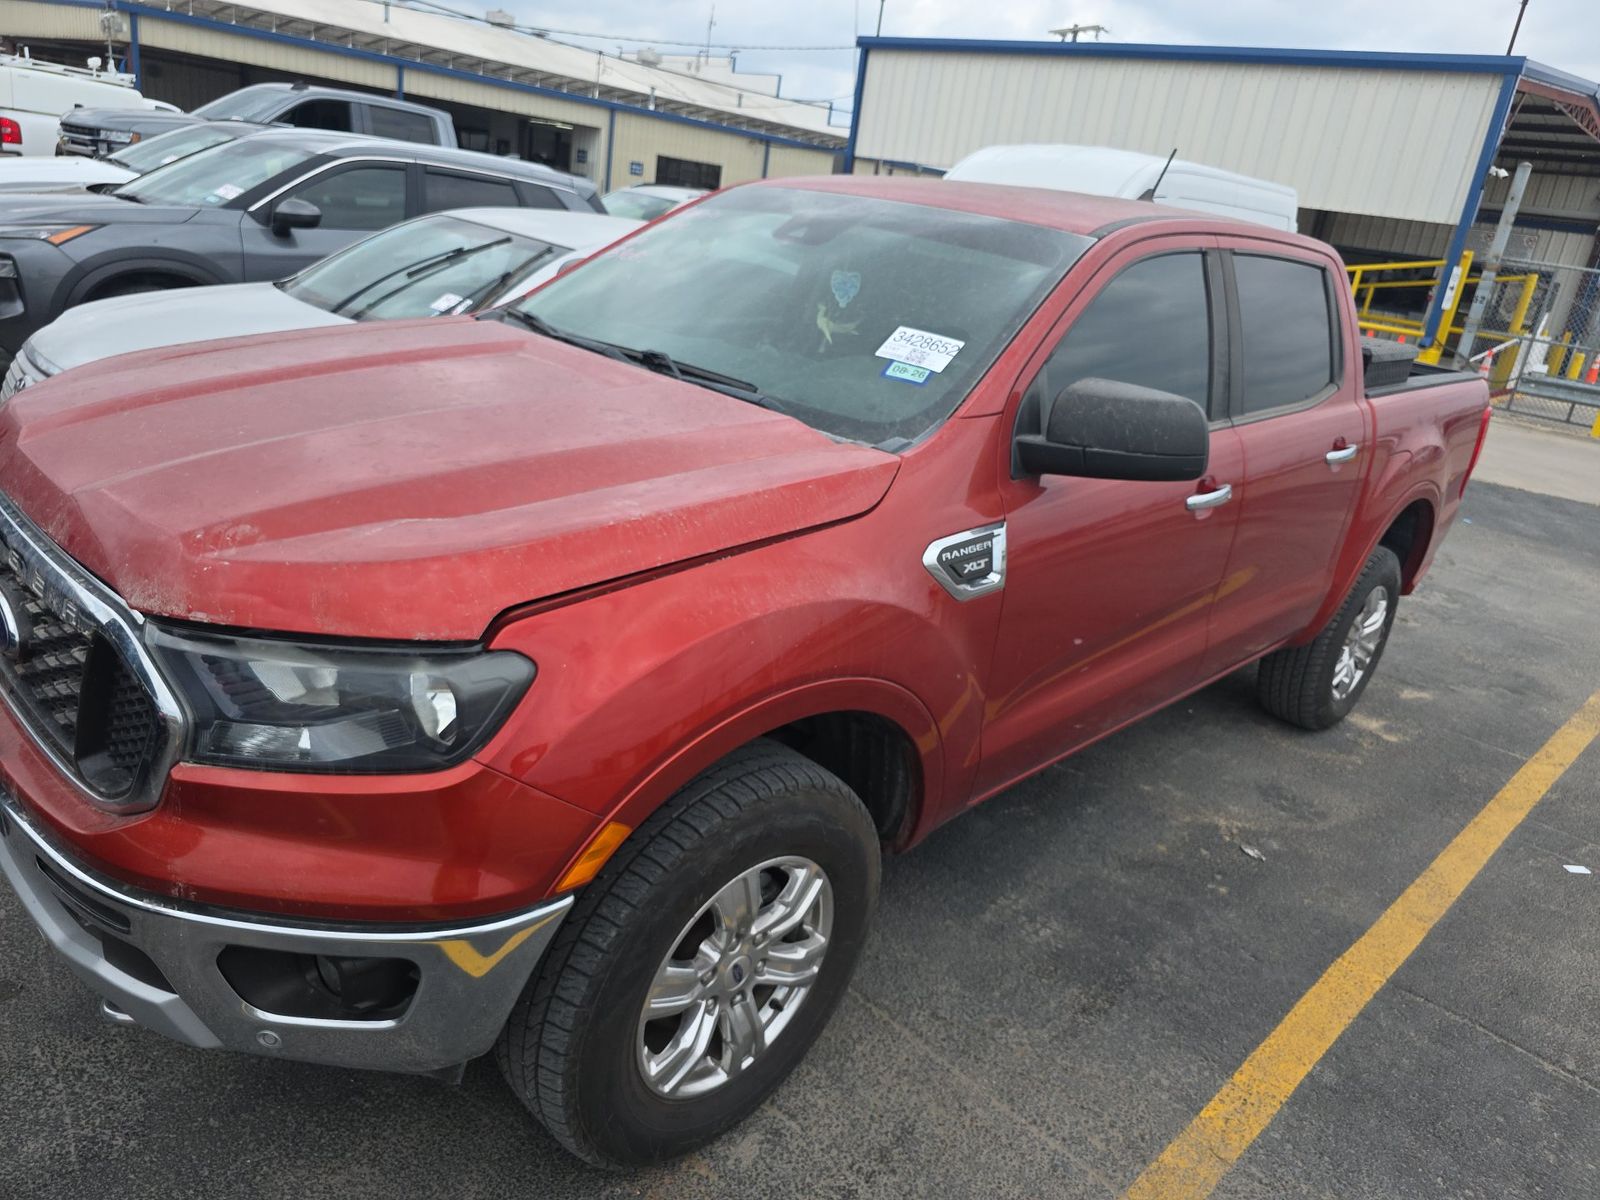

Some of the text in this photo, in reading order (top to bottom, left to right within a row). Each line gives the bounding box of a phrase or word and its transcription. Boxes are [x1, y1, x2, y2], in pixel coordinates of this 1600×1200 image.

[893, 331, 961, 357] 3428652
[941, 541, 992, 561] RANGER
[963, 558, 989, 574] XLT
